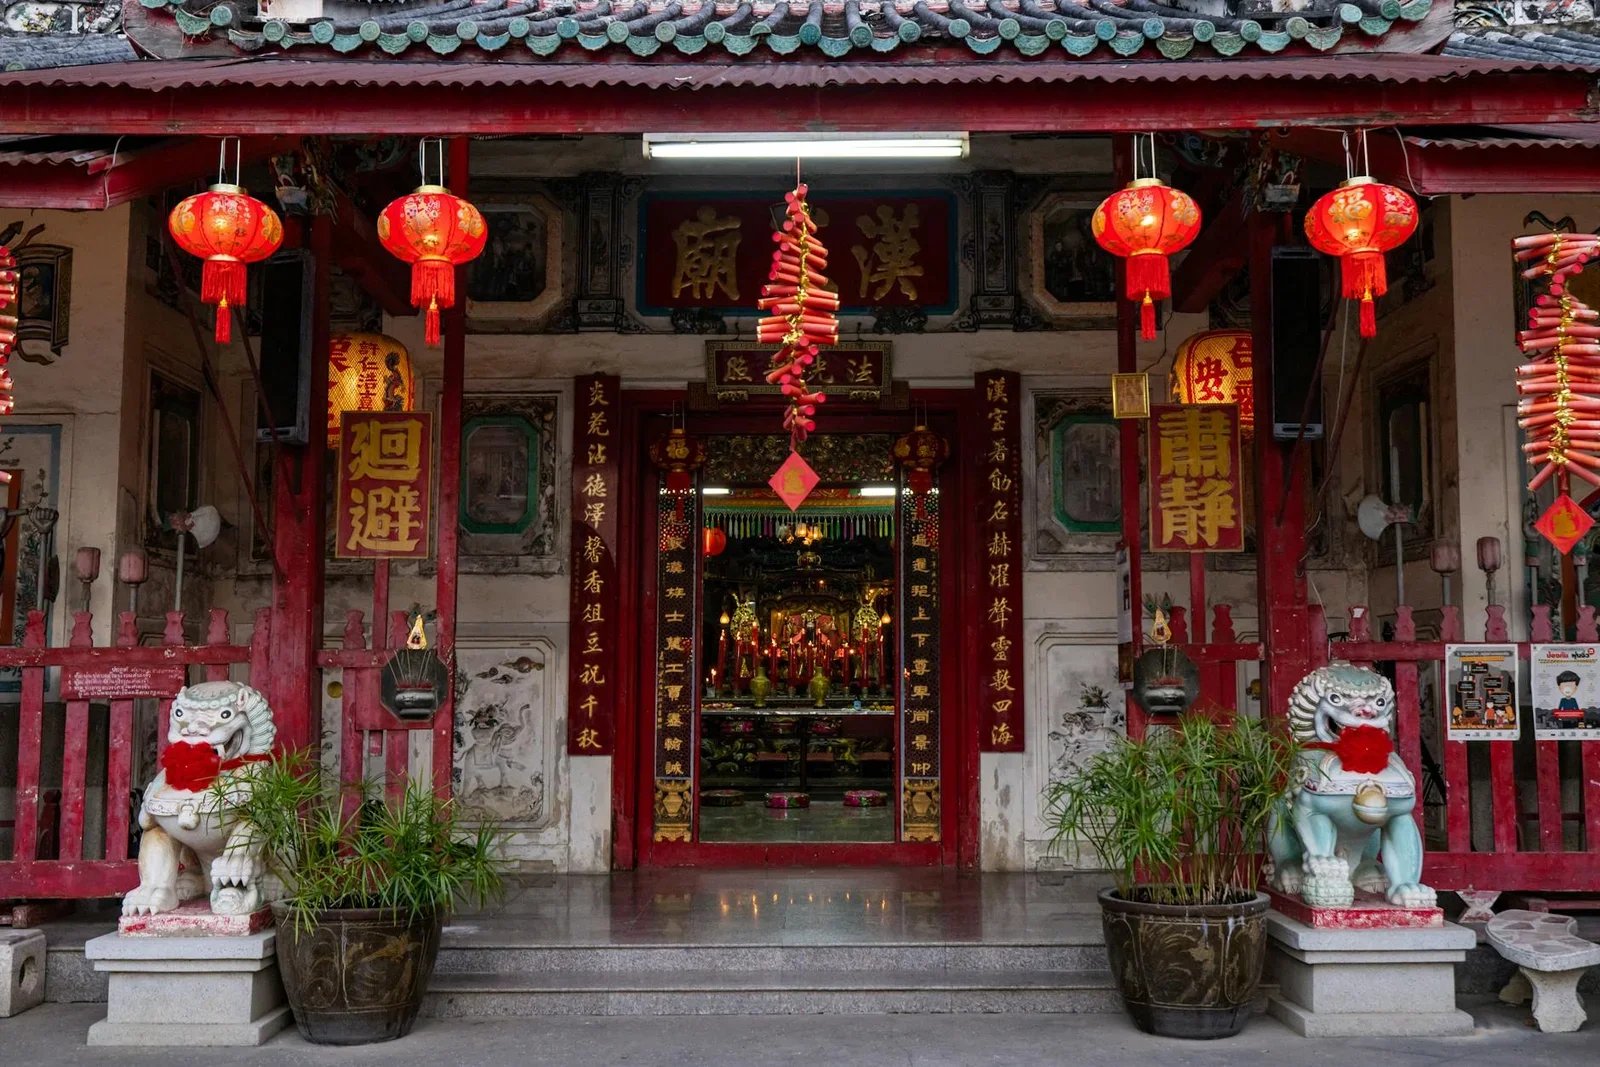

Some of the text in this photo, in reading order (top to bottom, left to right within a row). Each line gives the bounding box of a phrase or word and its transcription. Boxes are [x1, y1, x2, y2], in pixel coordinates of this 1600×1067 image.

[672, 203, 924, 301] 漢廟
[724, 355, 874, 384] 法光照
